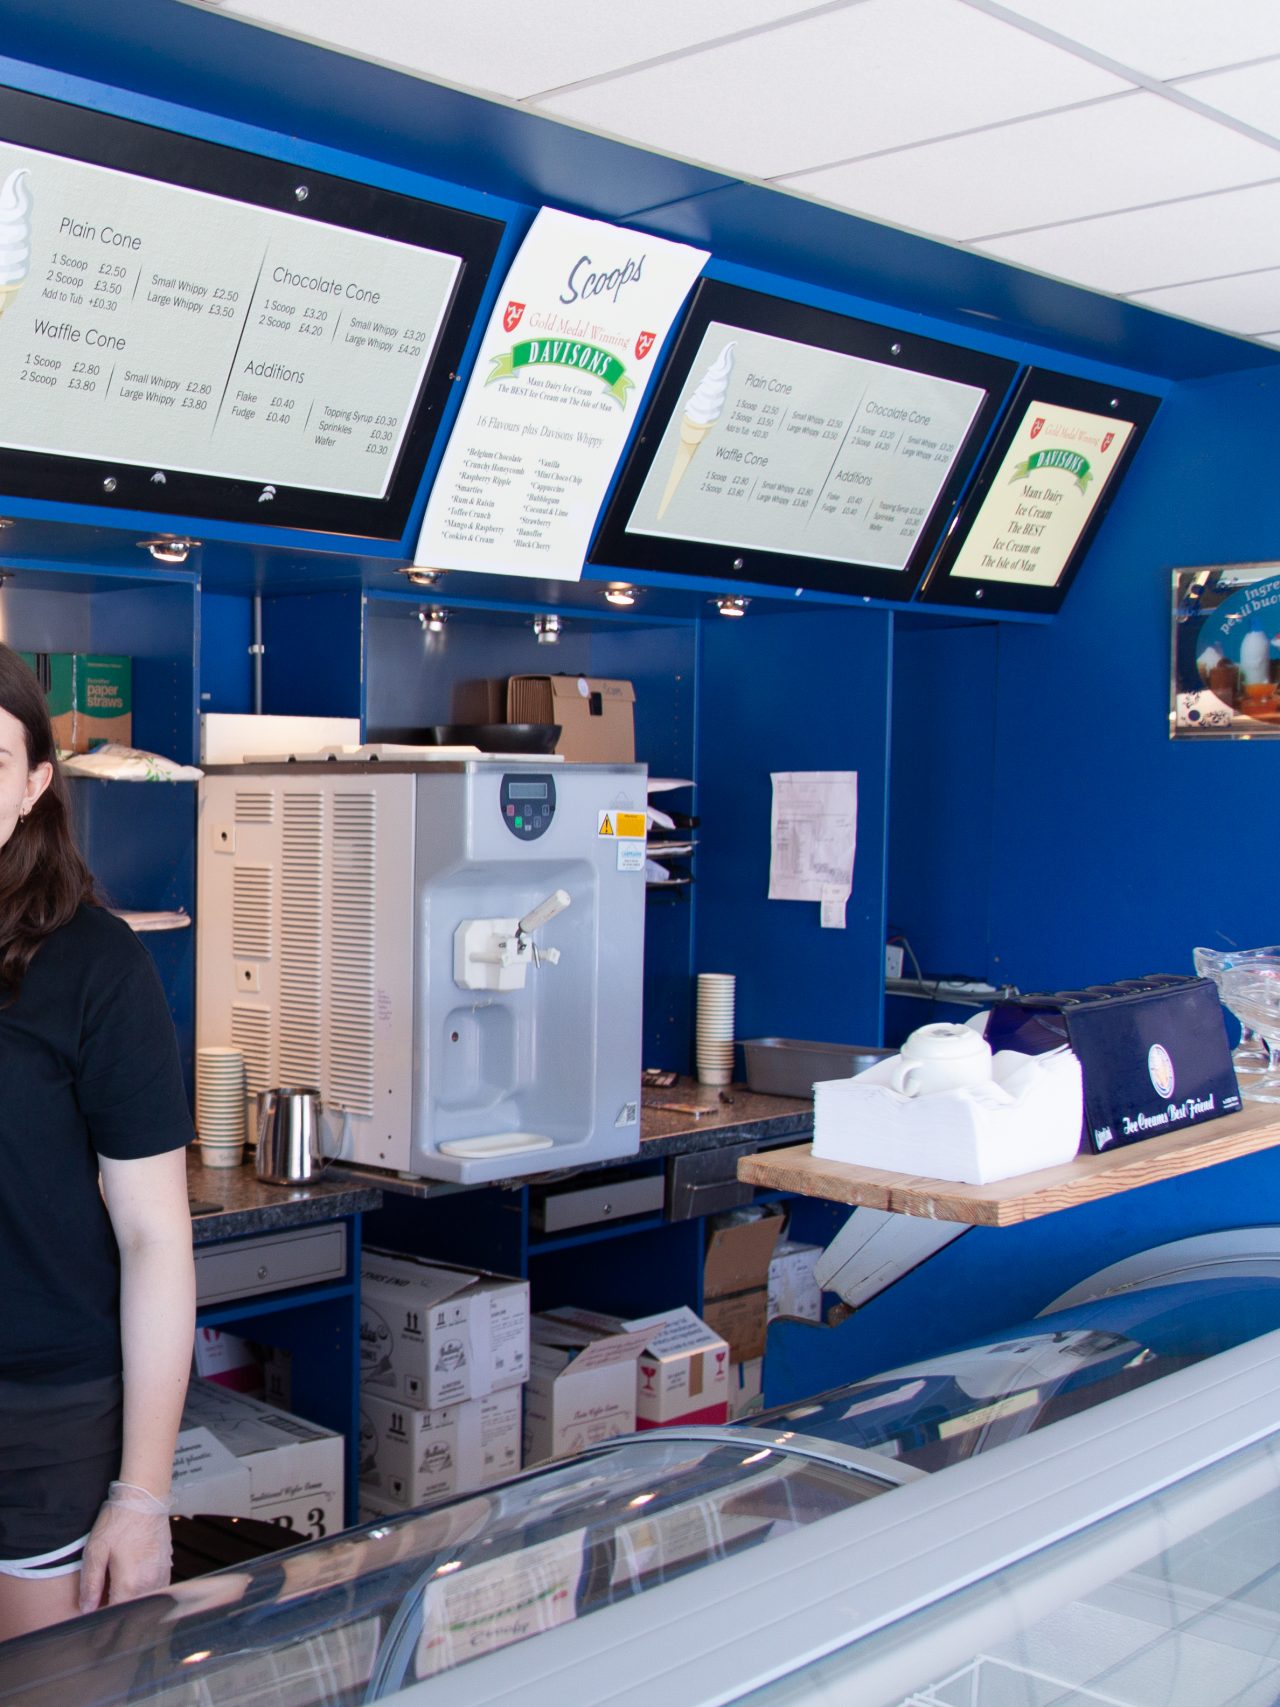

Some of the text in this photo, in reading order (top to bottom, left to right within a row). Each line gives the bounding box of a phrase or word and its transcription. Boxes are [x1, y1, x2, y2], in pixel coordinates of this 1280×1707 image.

[59, 217, 142, 251] Plain Cone
[60, 254, 89, 271] Scoop
[98, 263, 127, 279] £2.50
[55, 271, 84, 288] Scoop
[94, 280, 122, 295] £3.50
[152, 275, 239, 303] Small Whippy £2.50
[272, 266, 381, 304] Chocolate Cone
[559, 254, 646, 304] Scoops
[41, 287, 118, 312] Add to Tub +£0.30
[147, 291, 235, 319] Large Whippy £3.50
[271, 300, 296, 315] Scoop
[303, 307, 328, 321] £3.20
[34, 318, 126, 351] Waffle Cone
[267, 316, 291, 331] Scoop
[298, 323, 323, 337] £4.20
[350, 317, 426, 343] Small Whippy £3.20
[529, 312, 631, 350] Gold Medal Winning
[345, 333, 421, 357] Large Whippy £4.20
[33, 355, 62, 370] Scoop
[72, 362, 100, 376] £2.80
[528, 341, 613, 377] DAVISONS
[29, 371, 57, 386] Scoop
[67, 378, 96, 392] £3.80
[124, 371, 212, 395] Small Whippy £2.80
[244, 360, 306, 385] Additions
[745, 373, 793, 395] Plain Cone
[120, 387, 207, 411] Large Whippy £3.80
[236, 391, 295, 410] Flake £0.40
[232, 406, 291, 425] Fudge £0.40
[324, 406, 398, 427] Topping Syrup £0.30
[866, 401, 931, 426] Chocolate Cone
[319, 421, 393, 441] Sprinkles £0.30
[476, 415, 604, 448] 16 Flavours plus Davisons Whippy
[314, 435, 388, 456] Wafer £0.30
[716, 446, 768, 467] Waffle Cone
[1036, 451, 1084, 474] DAVISONS
[835, 470, 872, 486] Additions
[1023, 485, 1063, 506] Manx Dairy
[1015, 503, 1052, 520] Ice Cream
[1007, 521, 1046, 537] The BEST
[992, 538, 1041, 554] Ice Cream on
[981, 555, 1035, 572] The Isle of Man
[1251, 594, 1280, 610] buo
[87, 685, 119, 697] paper
[87, 696, 123, 708] straws
[1138, 1112, 1169, 1130] Creams
[1169, 1104, 1187, 1121] Best
[1186, 1093, 1214, 1119] Friend
